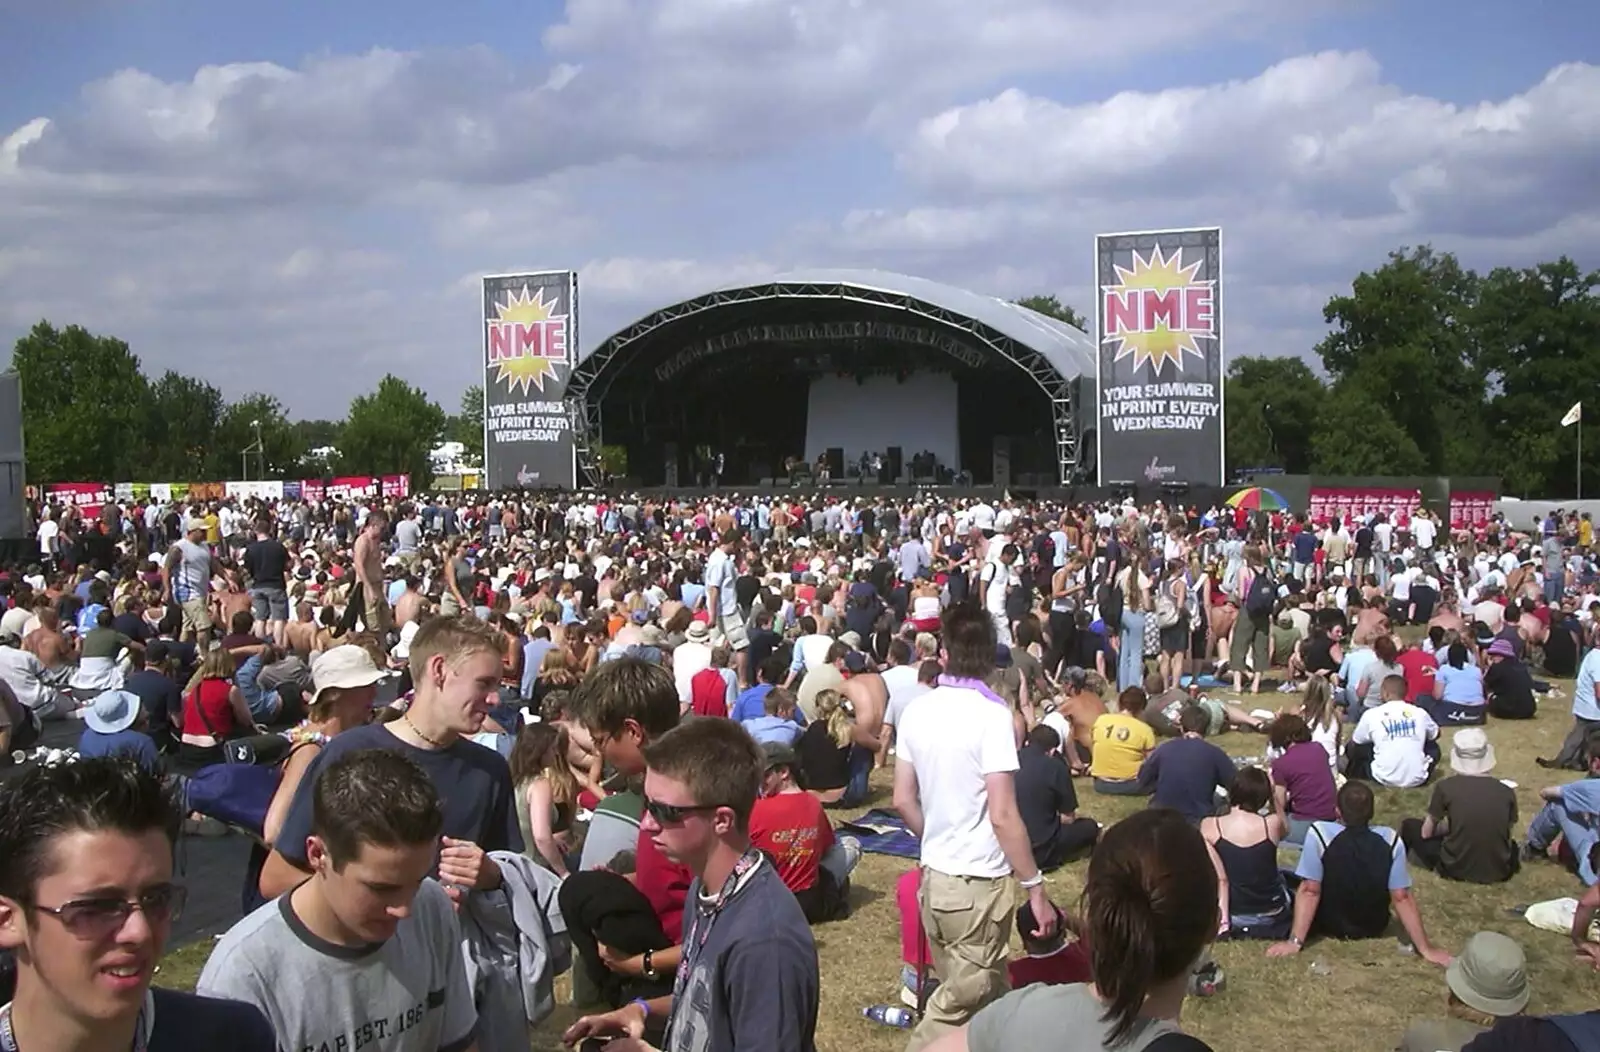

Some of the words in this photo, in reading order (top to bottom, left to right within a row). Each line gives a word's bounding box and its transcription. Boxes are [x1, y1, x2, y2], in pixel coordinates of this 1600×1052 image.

[1104, 286, 1214, 337] NME
[488, 319, 567, 362] NME
[1104, 385, 1142, 401] YOUR
[1144, 382, 1214, 397] SUMMER
[489, 403, 516, 417] YOUR
[517, 401, 566, 414] SUMMER
[1102, 402, 1118, 417] IN
[1120, 400, 1167, 415] PRINT
[1169, 400, 1220, 417] EVERY
[488, 418, 500, 430] IN
[500, 416, 533, 429] PRINT
[1112, 415, 1206, 431] WEDNESDAY
[494, 429, 561, 443] WEDNESDAY
[1105, 724, 1131, 742] 10
[354, 1018, 393, 1050] EST.
